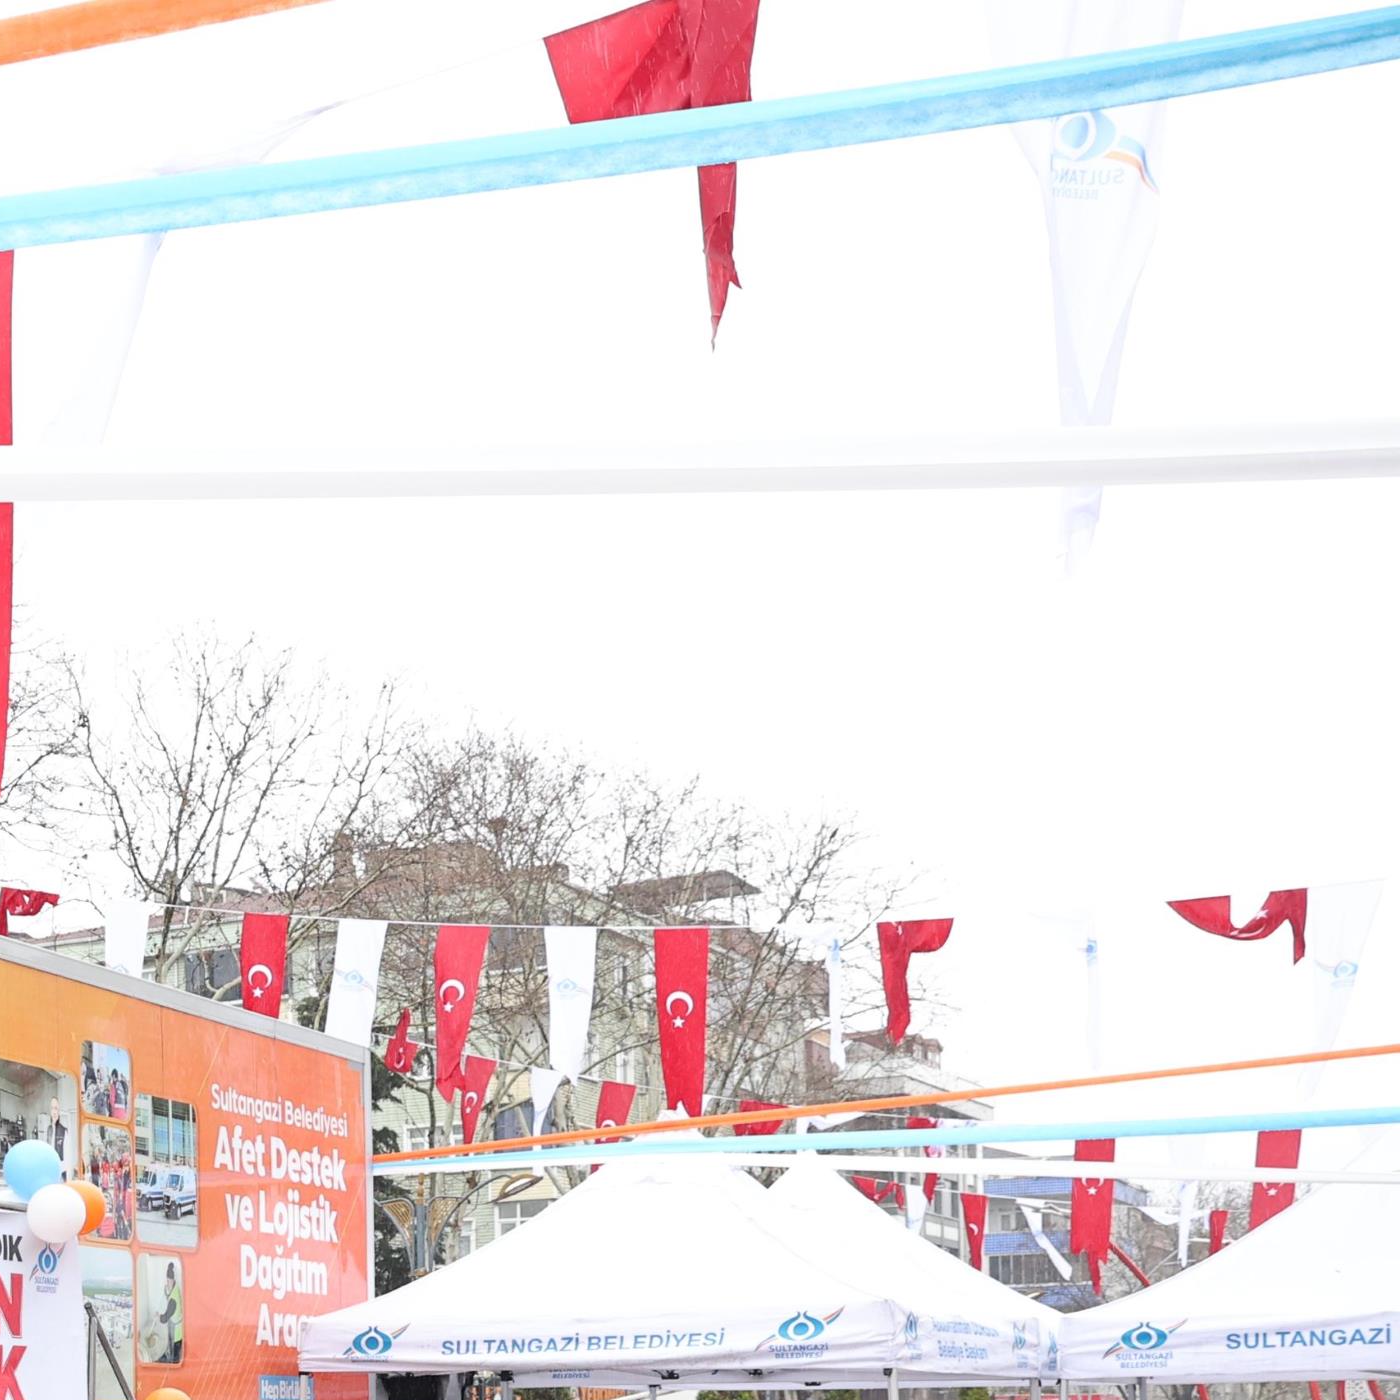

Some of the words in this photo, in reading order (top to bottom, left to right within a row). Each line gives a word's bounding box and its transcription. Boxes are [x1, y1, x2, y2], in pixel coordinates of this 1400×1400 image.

[211, 1083, 281, 1124] Sultangazi
[284, 1100, 348, 1138] Belediyesi
[214, 1125, 265, 1176] Afet
[270, 1137, 347, 1192] Destek
[225, 1192, 253, 1232] ve
[259, 1190, 339, 1248] Lojistik
[240, 1243, 328, 1300] Dağıtım
[441, 1332, 580, 1356] SULTANGAZİ
[587, 1328, 725, 1351] BELEDİYESİ
[768, 1342, 829, 1353] SULTANGAZİ
[1226, 1323, 1391, 1349] SULTANGAZİ
[1115, 1350, 1173, 1361] SULTANGAZİ
[1120, 1359, 1168, 1369] BELEDİYESİ
